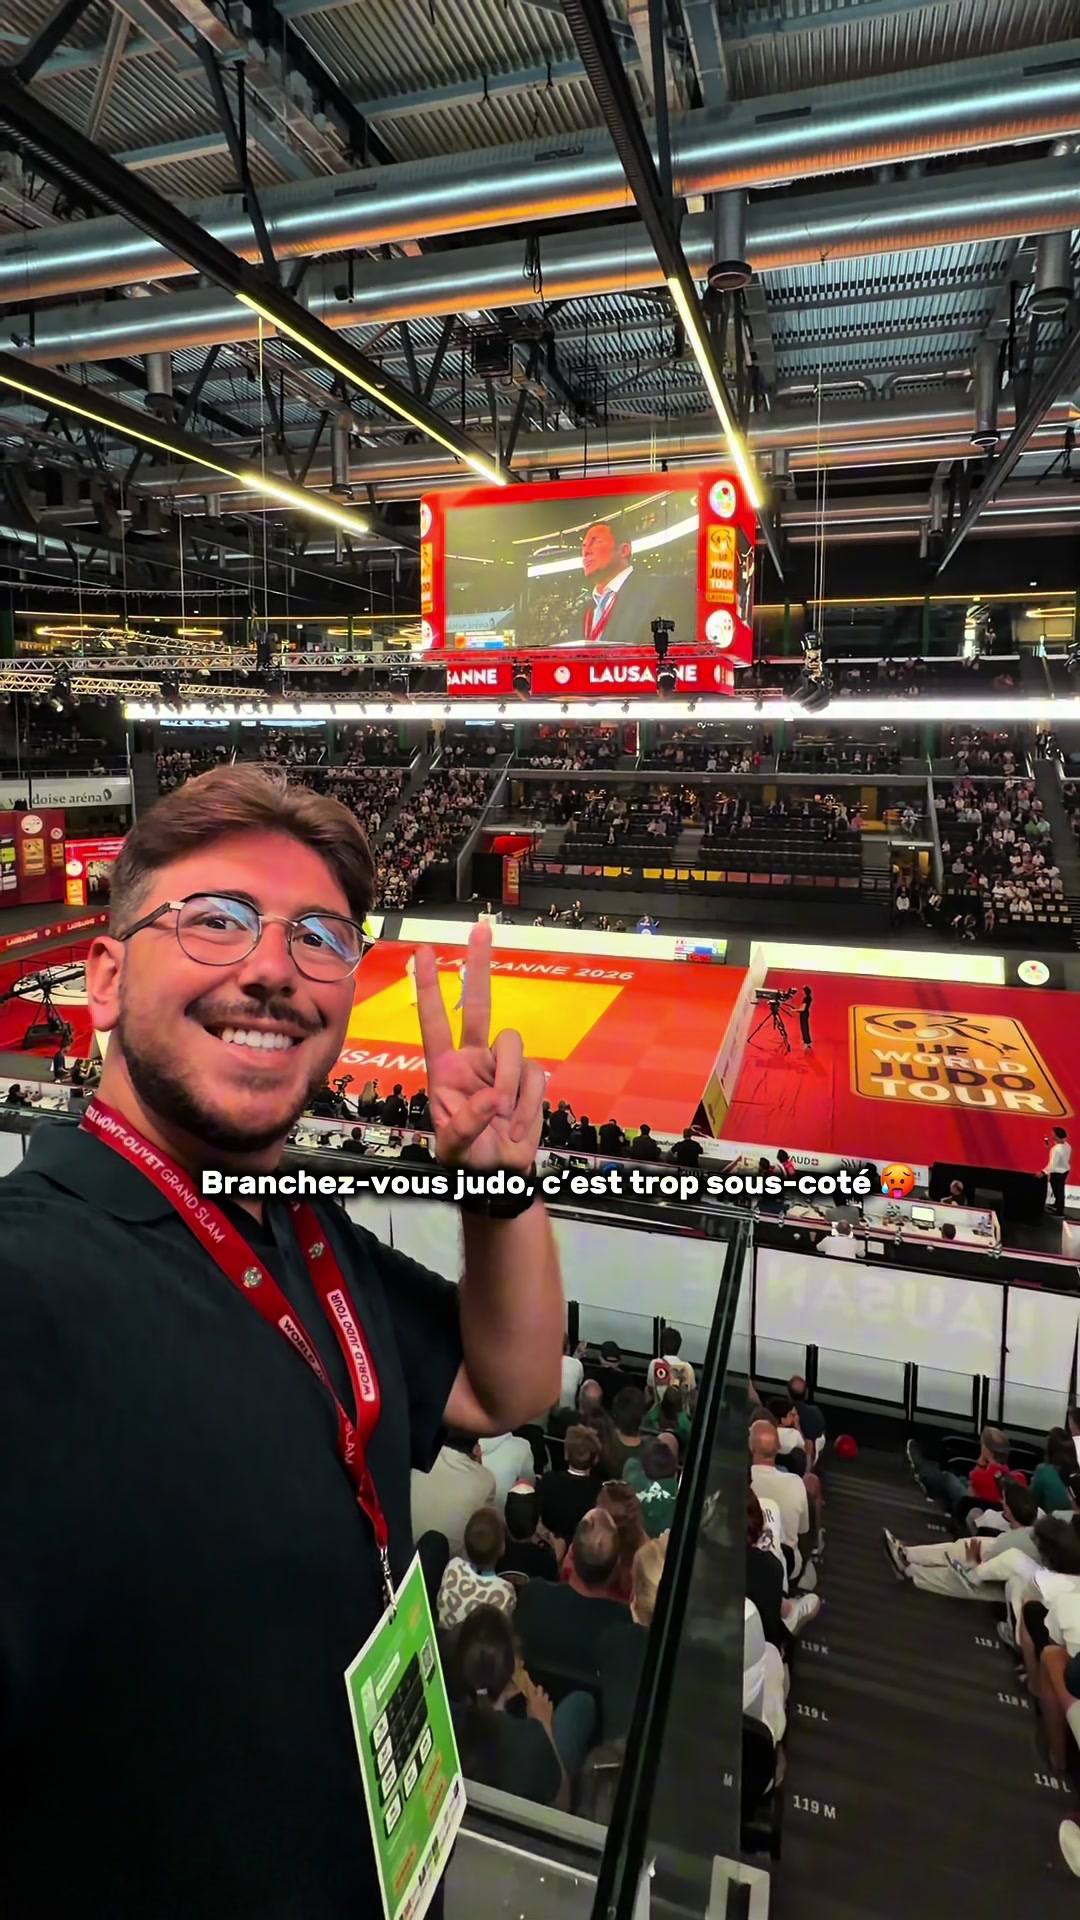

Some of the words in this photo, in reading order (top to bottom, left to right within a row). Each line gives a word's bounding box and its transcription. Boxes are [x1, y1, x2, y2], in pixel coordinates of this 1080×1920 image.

[709, 568, 733, 580] JUDO
[590, 665, 697, 683] LAUSANE
[69, 793, 102, 803] aréna
[434, 956, 570, 975] LASANNE
[573, 968, 635, 980] 2026
[871, 1048, 1028, 1074] WORLD
[916, 1043, 969, 1056] IJF
[870, 1061, 1036, 1092] JUDO
[870, 1077, 1050, 1113] TOUR
[160, 1168, 200, 1210] GRAND
[194, 1206, 226, 1244] SLAM
[331, 1293, 348, 1320] TOUR
[283, 1318, 316, 1364] WORLD
[343, 1320, 360, 1349] JUDO
[355, 1351, 371, 1396] WORLD
[344, 1420, 355, 1465] SLAM
[797, 1704, 819, 1718] 119
[821, 1711, 829, 1721] L
[1062, 1779, 1071, 1793] L
[793, 1795, 820, 1814] 119
[823, 1804, 836, 1819] M
